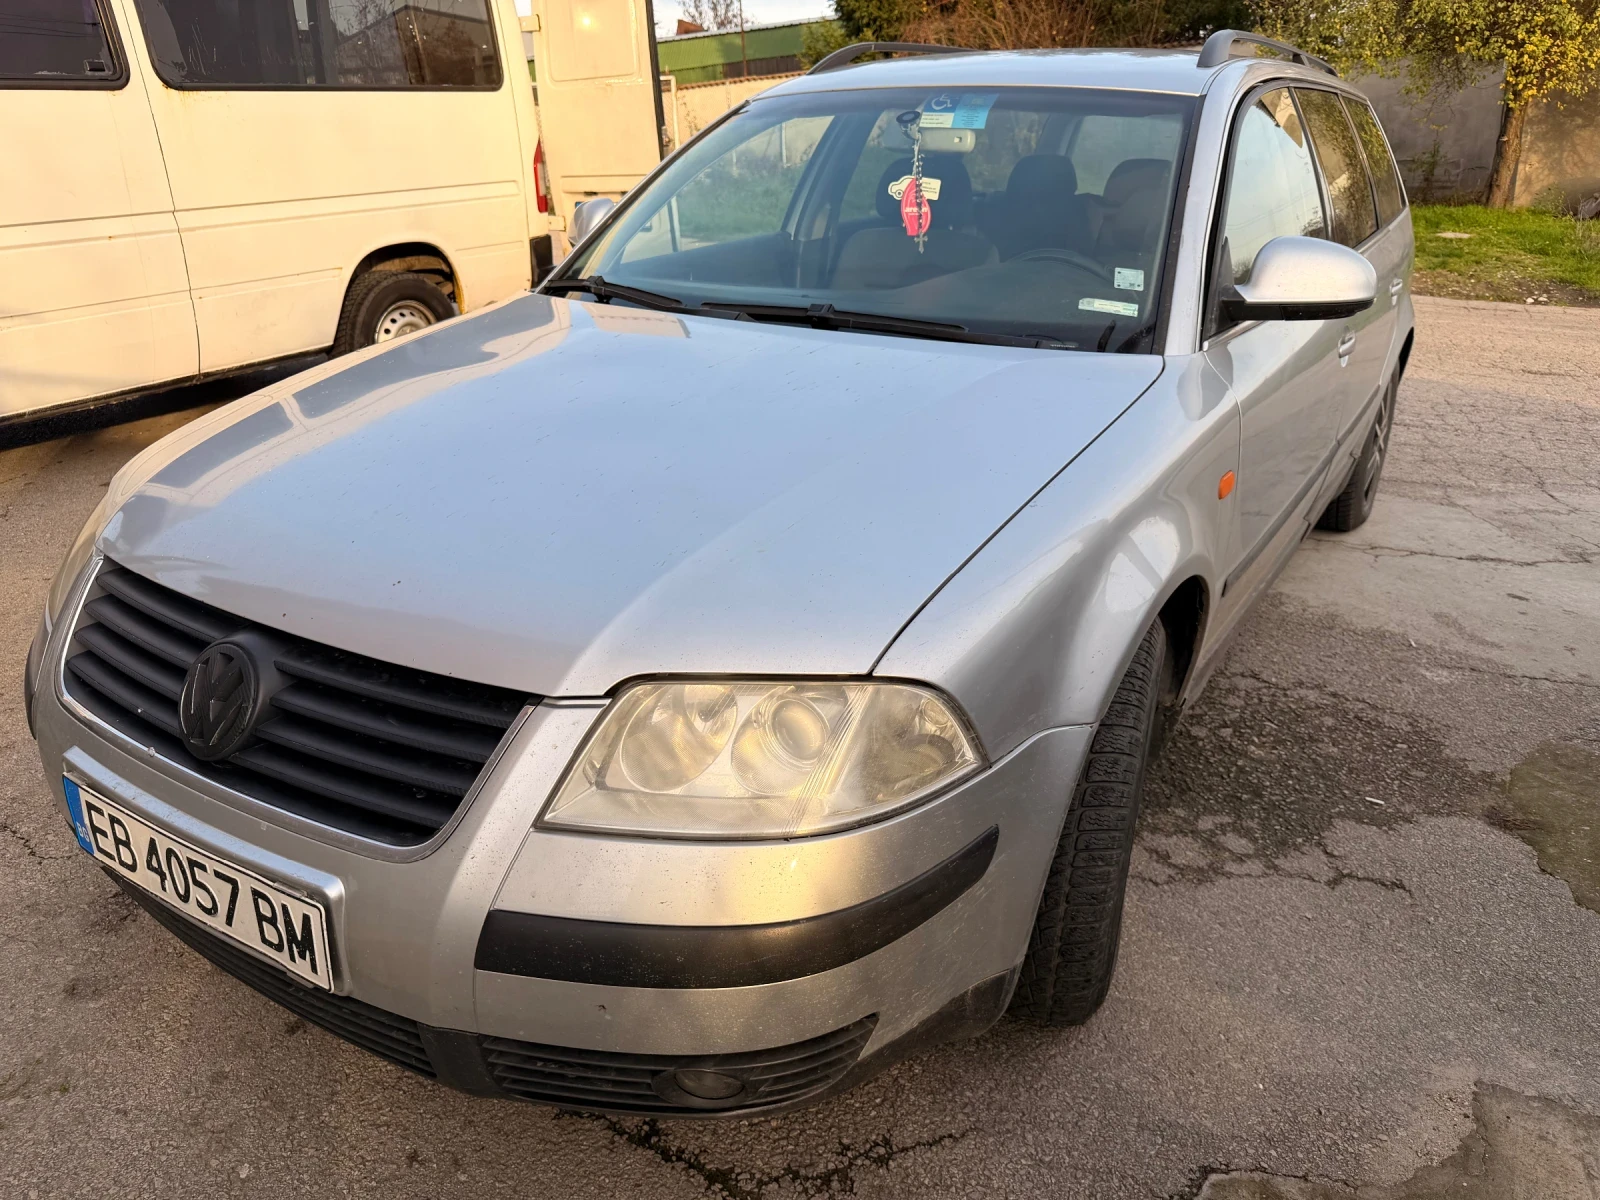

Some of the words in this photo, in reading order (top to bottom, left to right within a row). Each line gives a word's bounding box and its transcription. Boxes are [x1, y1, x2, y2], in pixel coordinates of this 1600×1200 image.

[76, 821, 90, 843] BG
[84, 799, 138, 873] EB
[146, 836, 240, 928] 4057
[250, 885, 319, 976] BM
